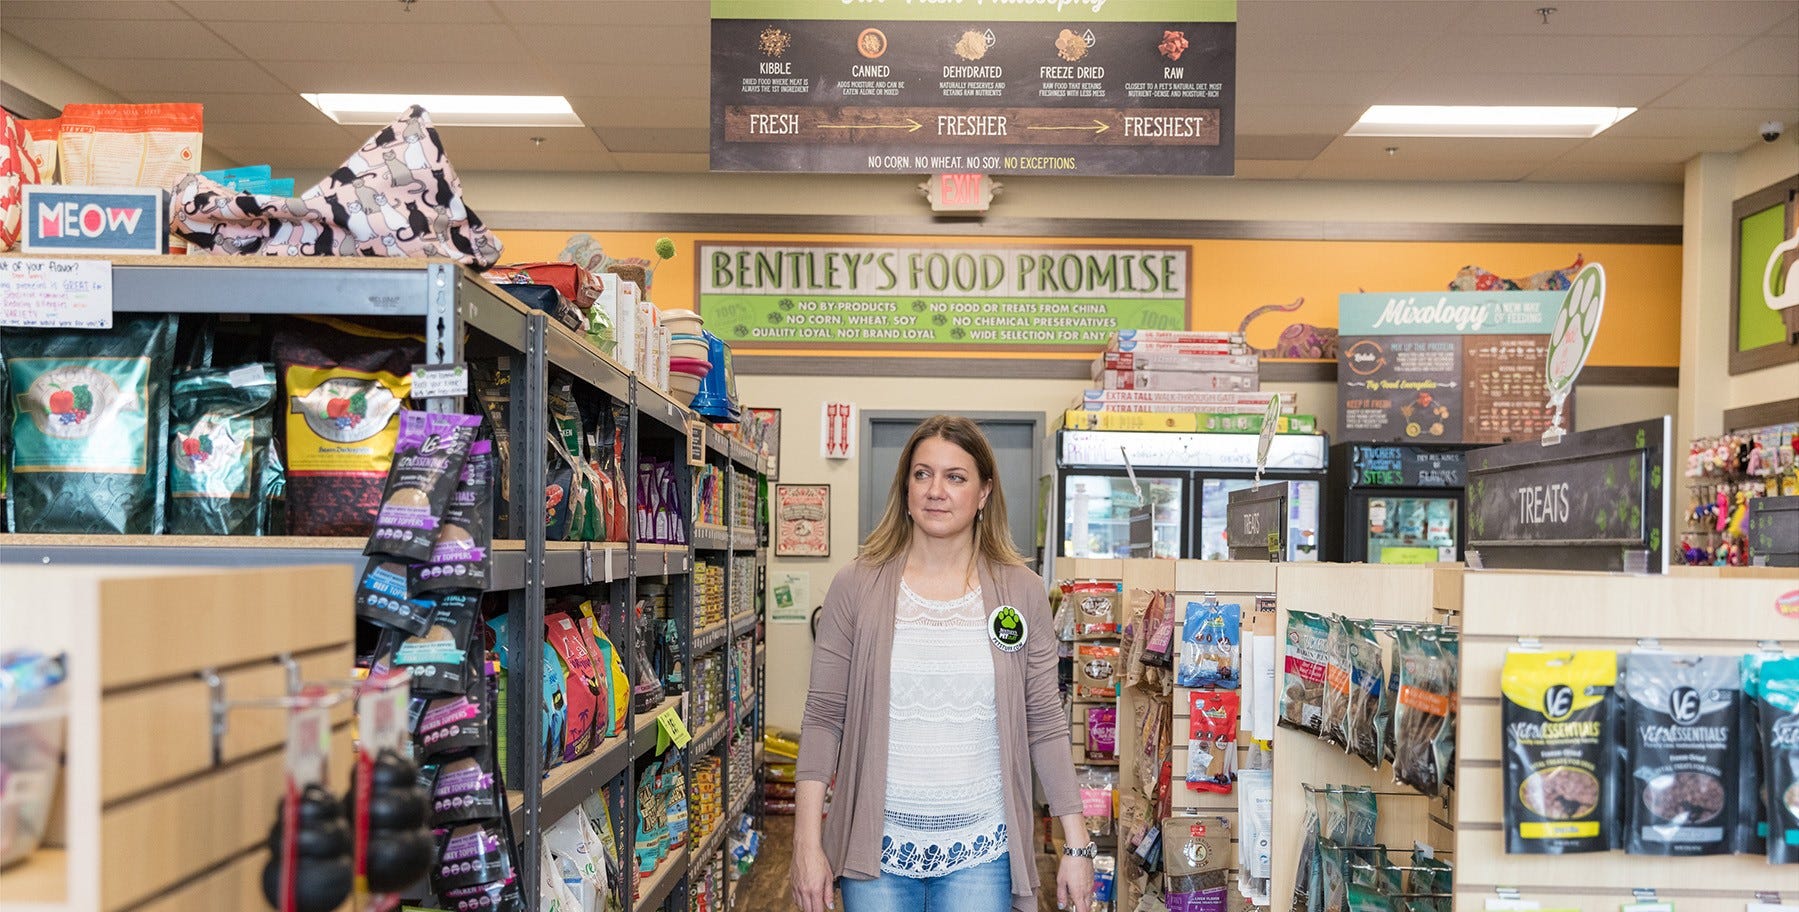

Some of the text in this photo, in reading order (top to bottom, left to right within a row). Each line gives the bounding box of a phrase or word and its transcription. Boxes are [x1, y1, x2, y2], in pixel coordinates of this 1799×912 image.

[760, 63, 791, 74] KIBBLE
[852, 66, 890, 77] CANNED
[943, 66, 1002, 78] DEHYDRATED
[1040, 67, 1104, 78] FREEZE DRIED
[1164, 68, 1184, 79] RAW
[750, 114, 800, 134] FRESH
[938, 116, 1008, 136] FRESHER
[1124, 116, 1203, 137] FRESHEST
[868, 156, 881, 169] NO
[884, 156, 912, 169] CORN.
[915, 156, 928, 169] NO
[967, 157, 980, 169] NO
[983, 157, 1001, 169] SOY.
[1004, 157, 1017, 169] NO
[1020, 157, 1077, 170] EXCEPTIONS.
[941, 174, 982, 205] EXIT
[38, 202, 142, 238] MEOW
[12, 261, 79, 275] of your flavor?
[712, 252, 1178, 292] BENTLEY'S FOOD PROMISE
[798, 302, 816, 312] NO
[930, 303, 1106, 314] NO FOOD OR TREATS FROM CHINA
[1372, 298, 1488, 332] Mixology
[1495, 313, 1542, 323] OF FEEDING
[786, 316, 805, 326] NO
[808, 316, 844, 326] CORN,
[894, 316, 916, 326] SOY
[953, 316, 1116, 327] NO CHEMICAL PRESERVATIVES
[752, 328, 795, 338] QUALITY
[838, 329, 860, 338] NOT
[864, 329, 899, 339] BRAND
[903, 329, 935, 339] LOYAL
[970, 330, 1106, 340] WIDE SELECTION FOR ANY
[1106, 392, 1132, 400] EXTRA
[1134, 392, 1152, 400] TALL
[1106, 404, 1132, 412] EXTRA
[1134, 404, 1152, 412] TALL
[1363, 470, 1404, 484] STEVE'S
[1519, 482, 1569, 524] TREATS
[1243, 512, 1260, 536] TREATS
